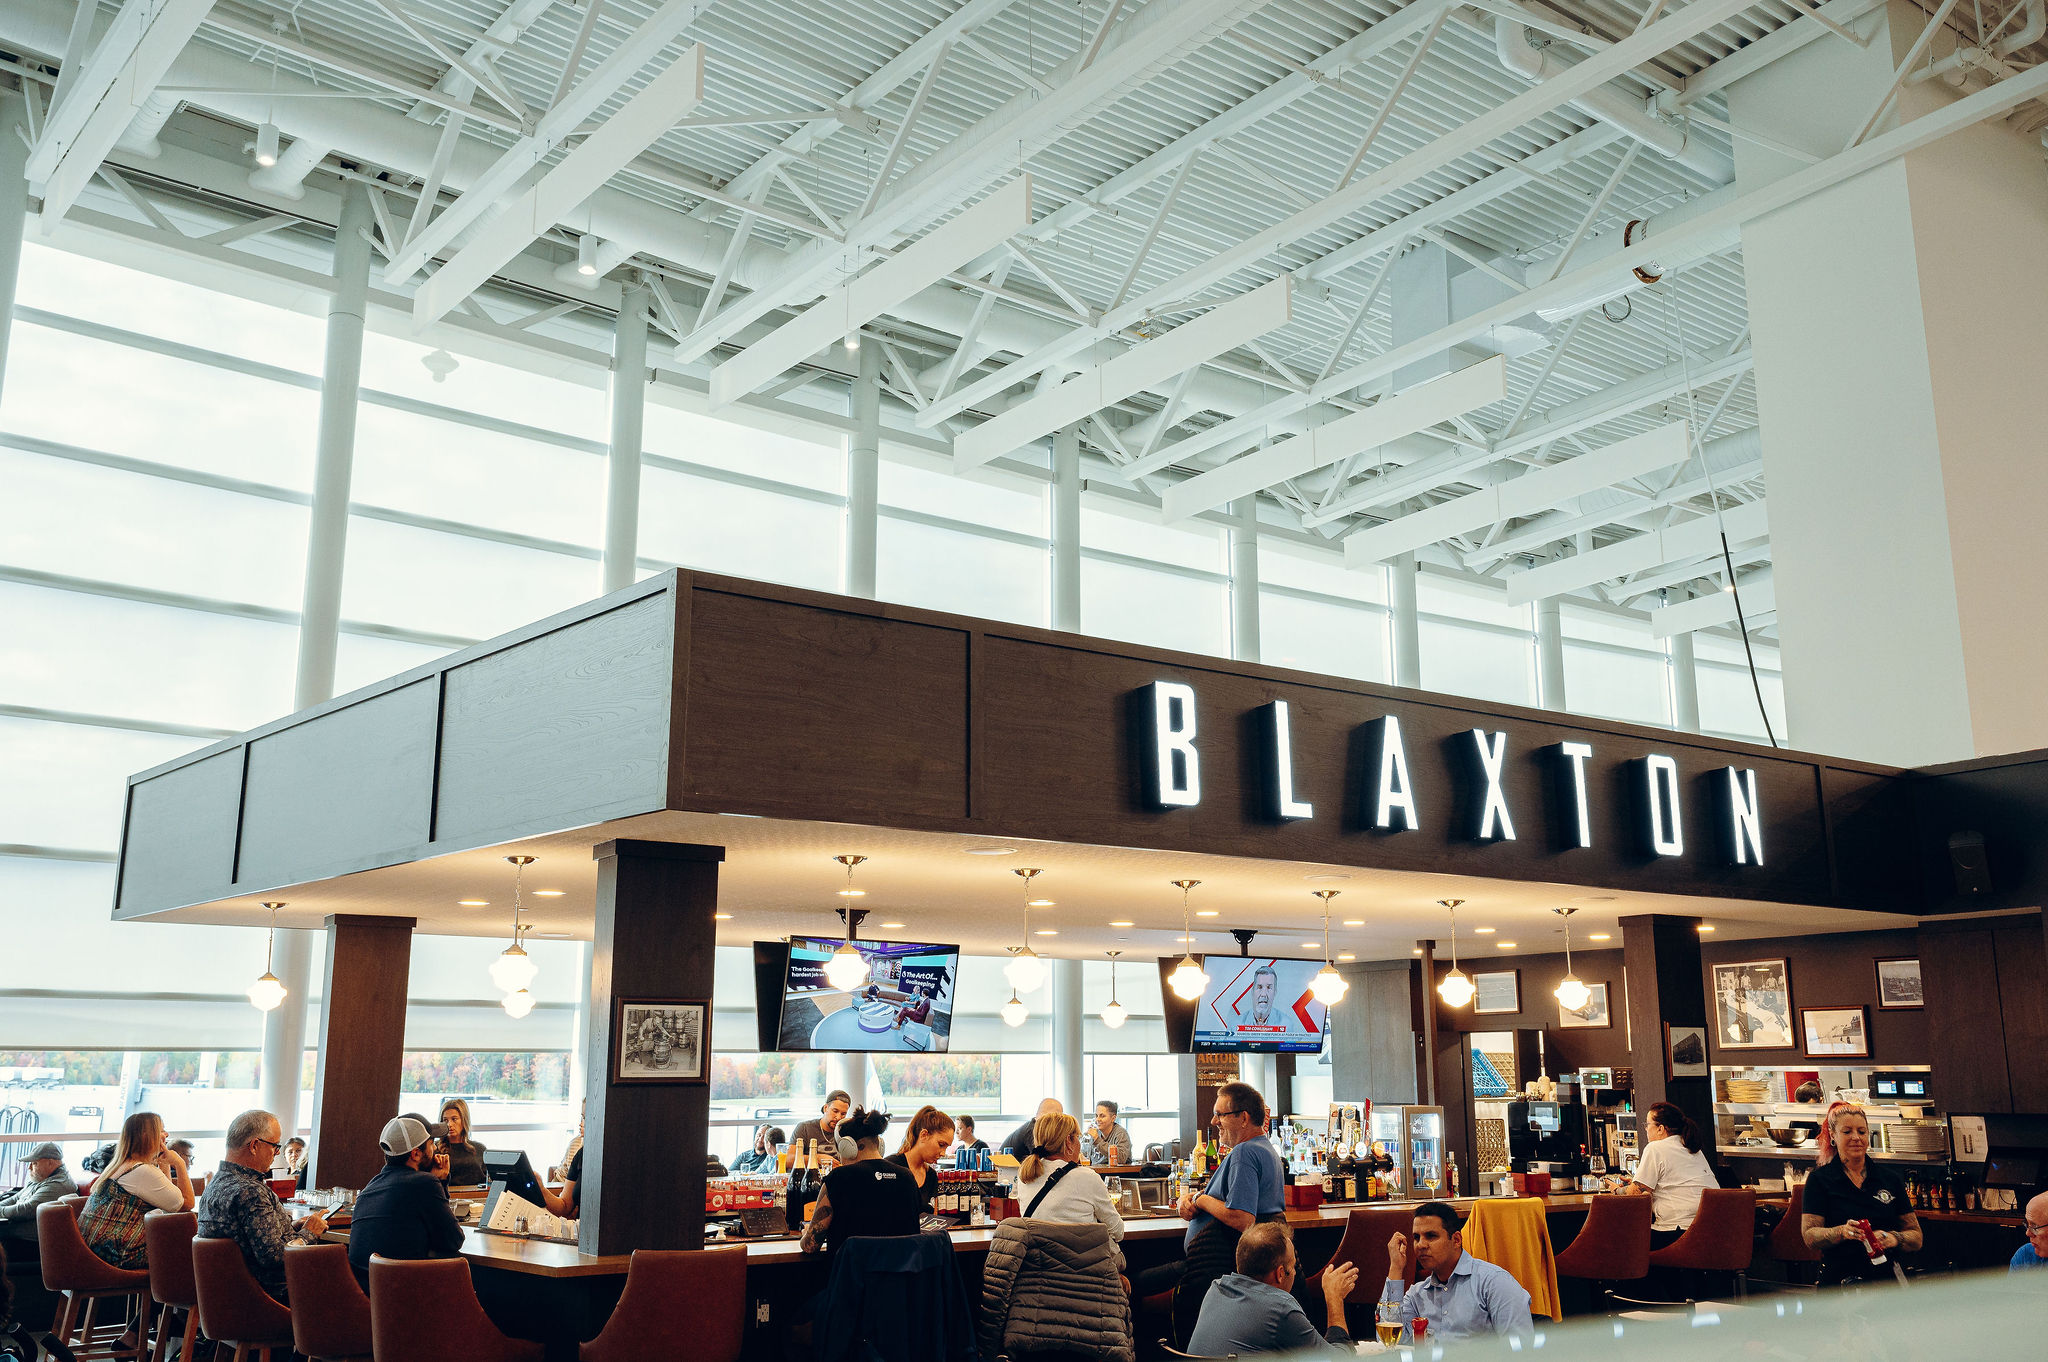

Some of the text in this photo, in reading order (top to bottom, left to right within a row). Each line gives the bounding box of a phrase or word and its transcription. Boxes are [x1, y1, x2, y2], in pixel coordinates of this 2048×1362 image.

[1153, 680, 1764, 866] BLAXTON
[905, 978, 936, 989] Goalkeeping
[1197, 1053, 1239, 1064] ARTOIS
